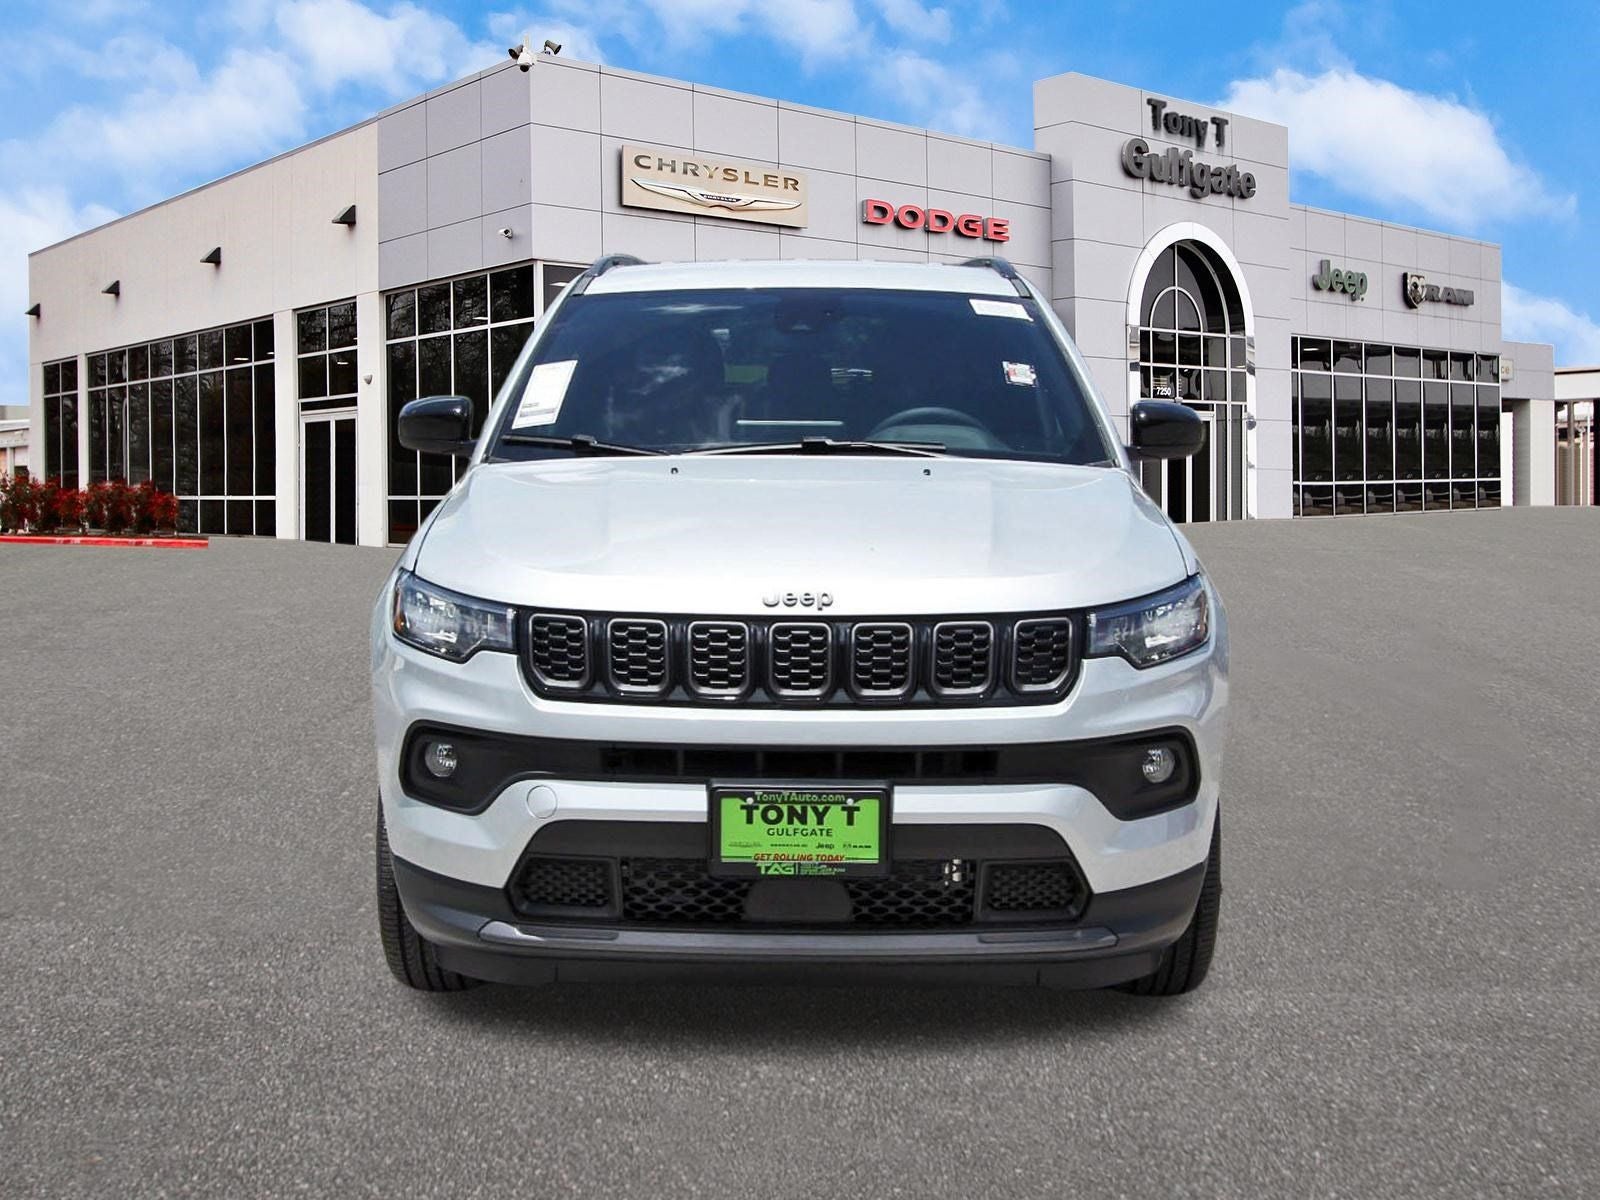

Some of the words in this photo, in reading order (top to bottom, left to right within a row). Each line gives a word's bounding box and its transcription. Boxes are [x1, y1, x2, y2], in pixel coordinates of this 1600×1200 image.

[1147, 98, 1208, 147] Tony
[1211, 116, 1229, 147] T
[633, 154, 800, 191] CHRYSLER
[1121, 138, 1257, 199] Gulfgate
[862, 198, 1010, 242] DODGE
[1312, 259, 1368, 301] Jeep
[1424, 284, 1475, 306] RAM
[1156, 387, 1171, 396] 7250
[762, 590, 834, 611] Jeep
[755, 791, 846, 804] TonyTAuto.com
[740, 804, 830, 826] TONY
[841, 805, 860, 826] T
[766, 828, 833, 837] GULFGATE
[815, 842, 835, 850] Jeep
[753, 853, 772, 861] GET
[774, 853, 813, 861] ROLLING
[815, 854, 846, 862] TODAY
